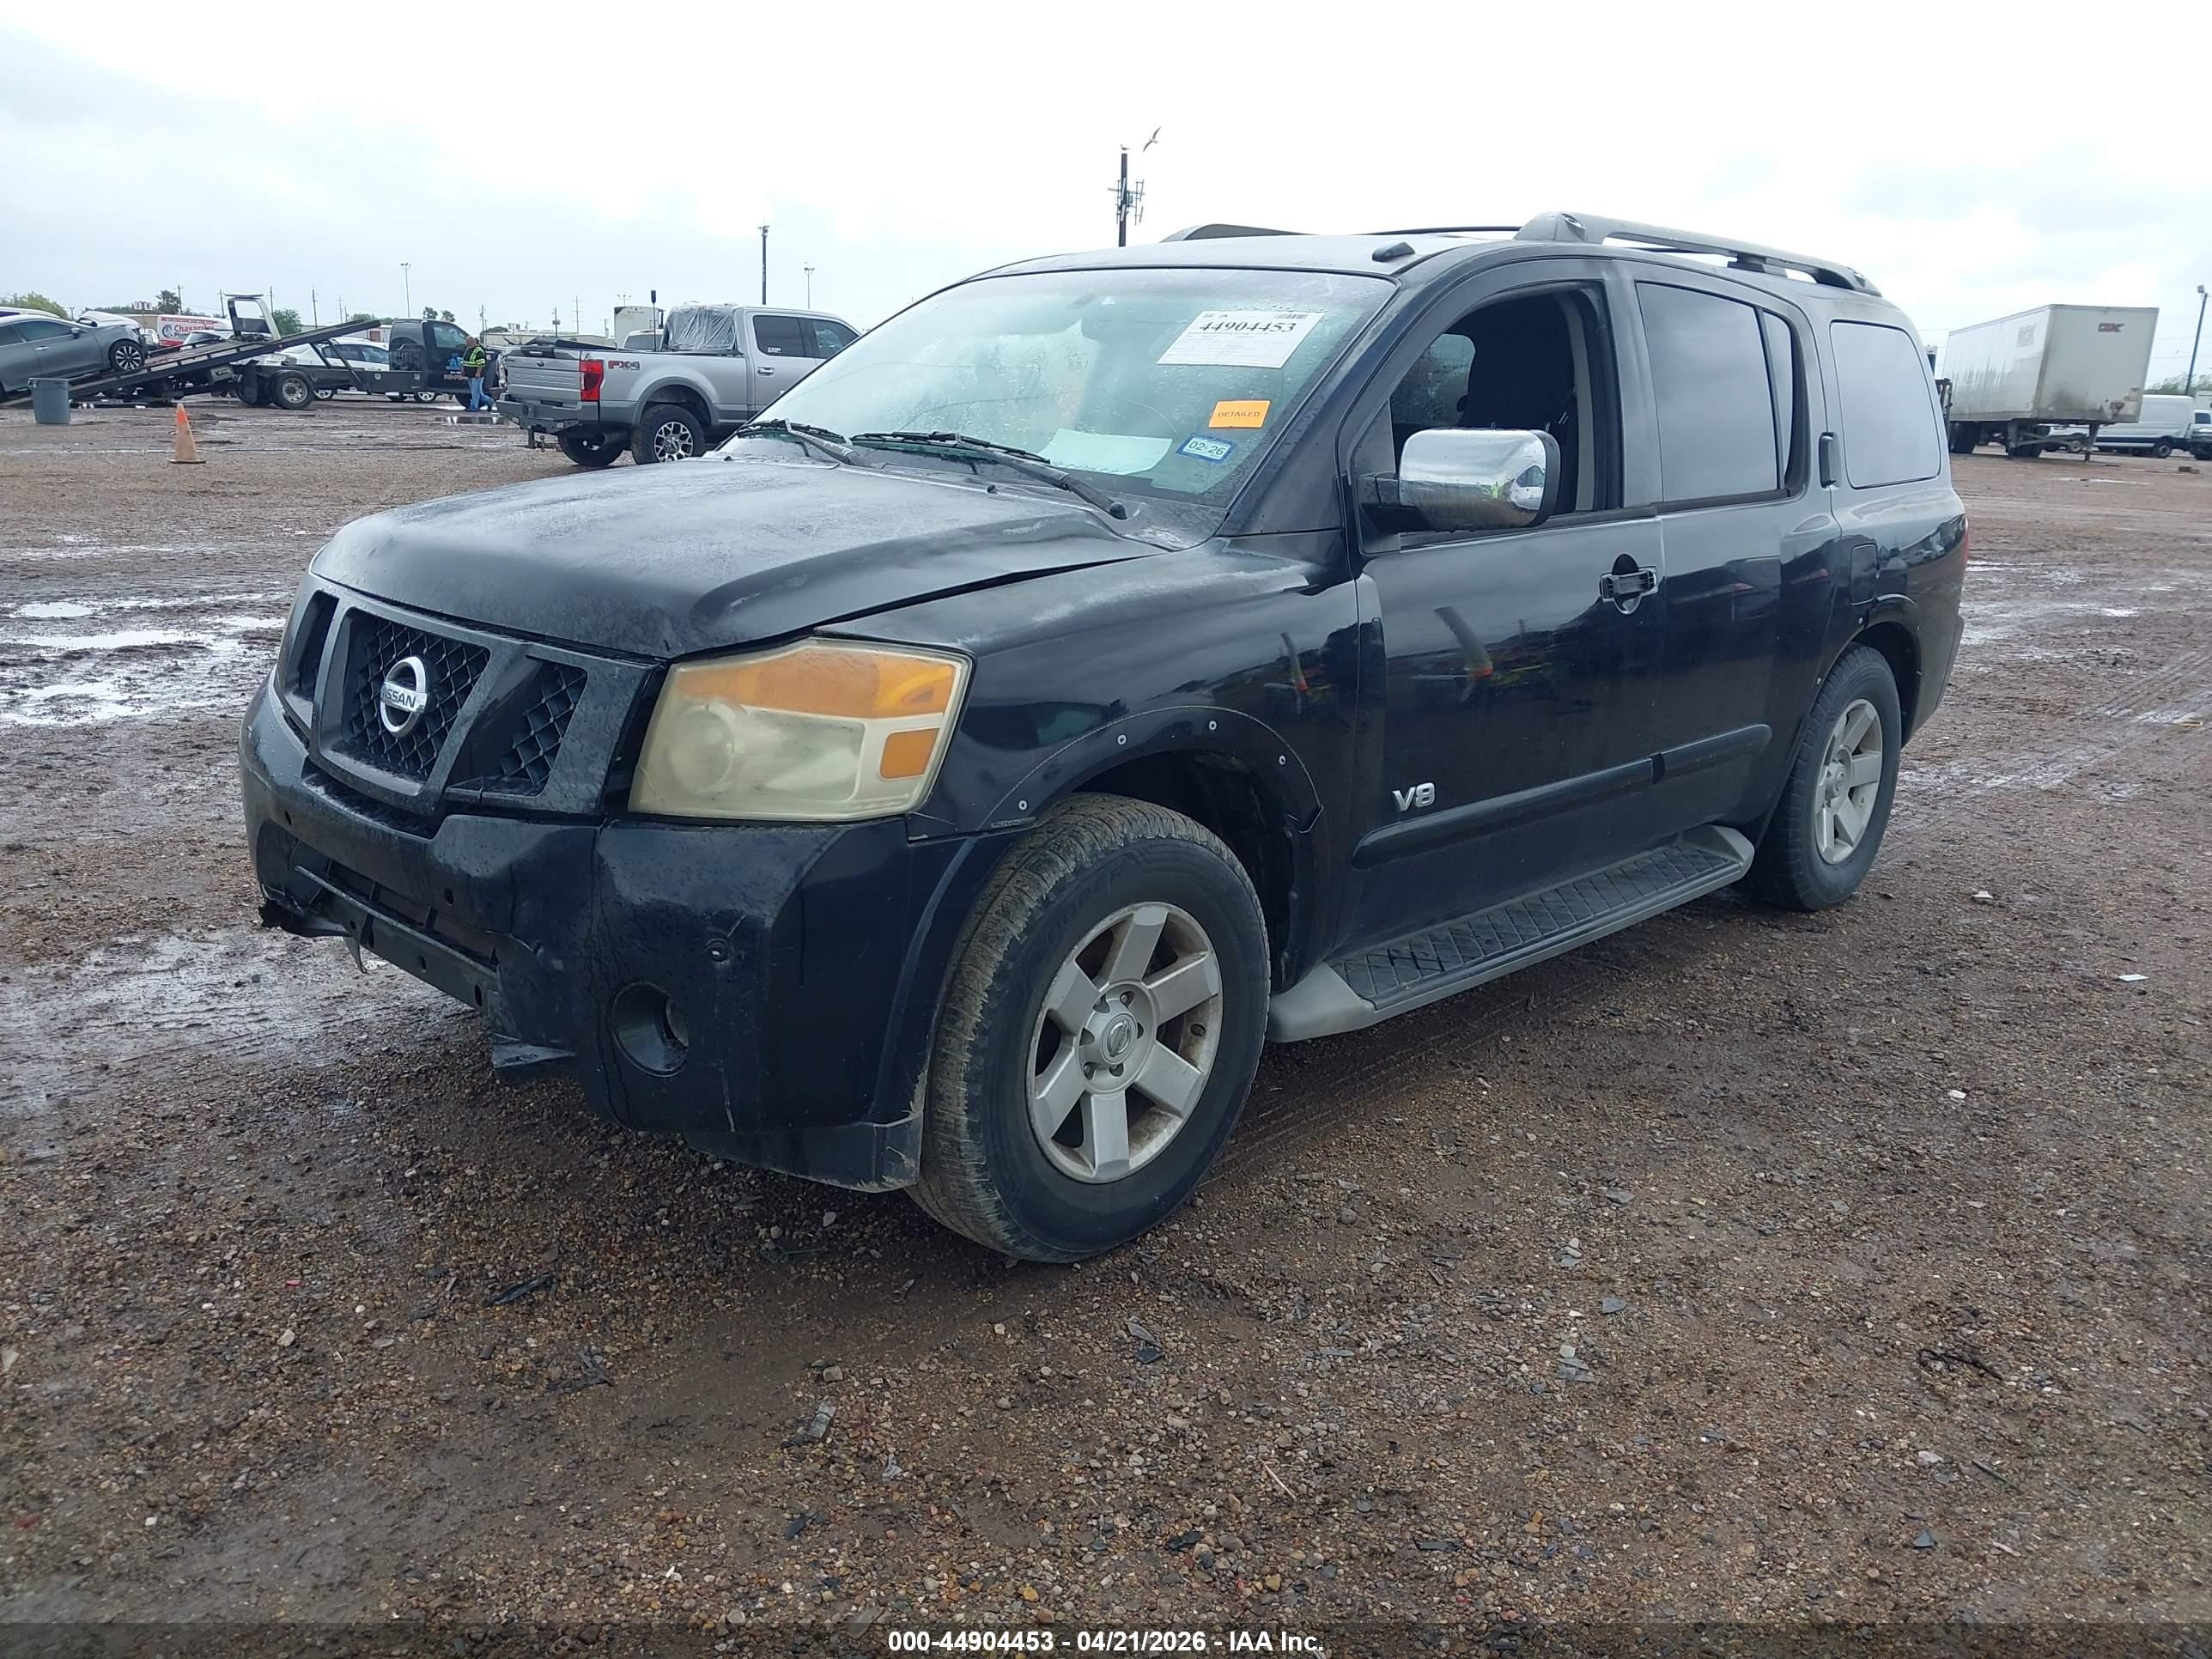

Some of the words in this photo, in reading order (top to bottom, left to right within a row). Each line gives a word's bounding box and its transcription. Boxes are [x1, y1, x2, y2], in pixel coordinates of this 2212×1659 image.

[1199, 321, 1297, 333] 44904453
[608, 361, 641, 370] FX4
[1188, 441, 1205, 451] 02
[1207, 445, 1226, 456] 26
[1392, 782, 1435, 811] V8
